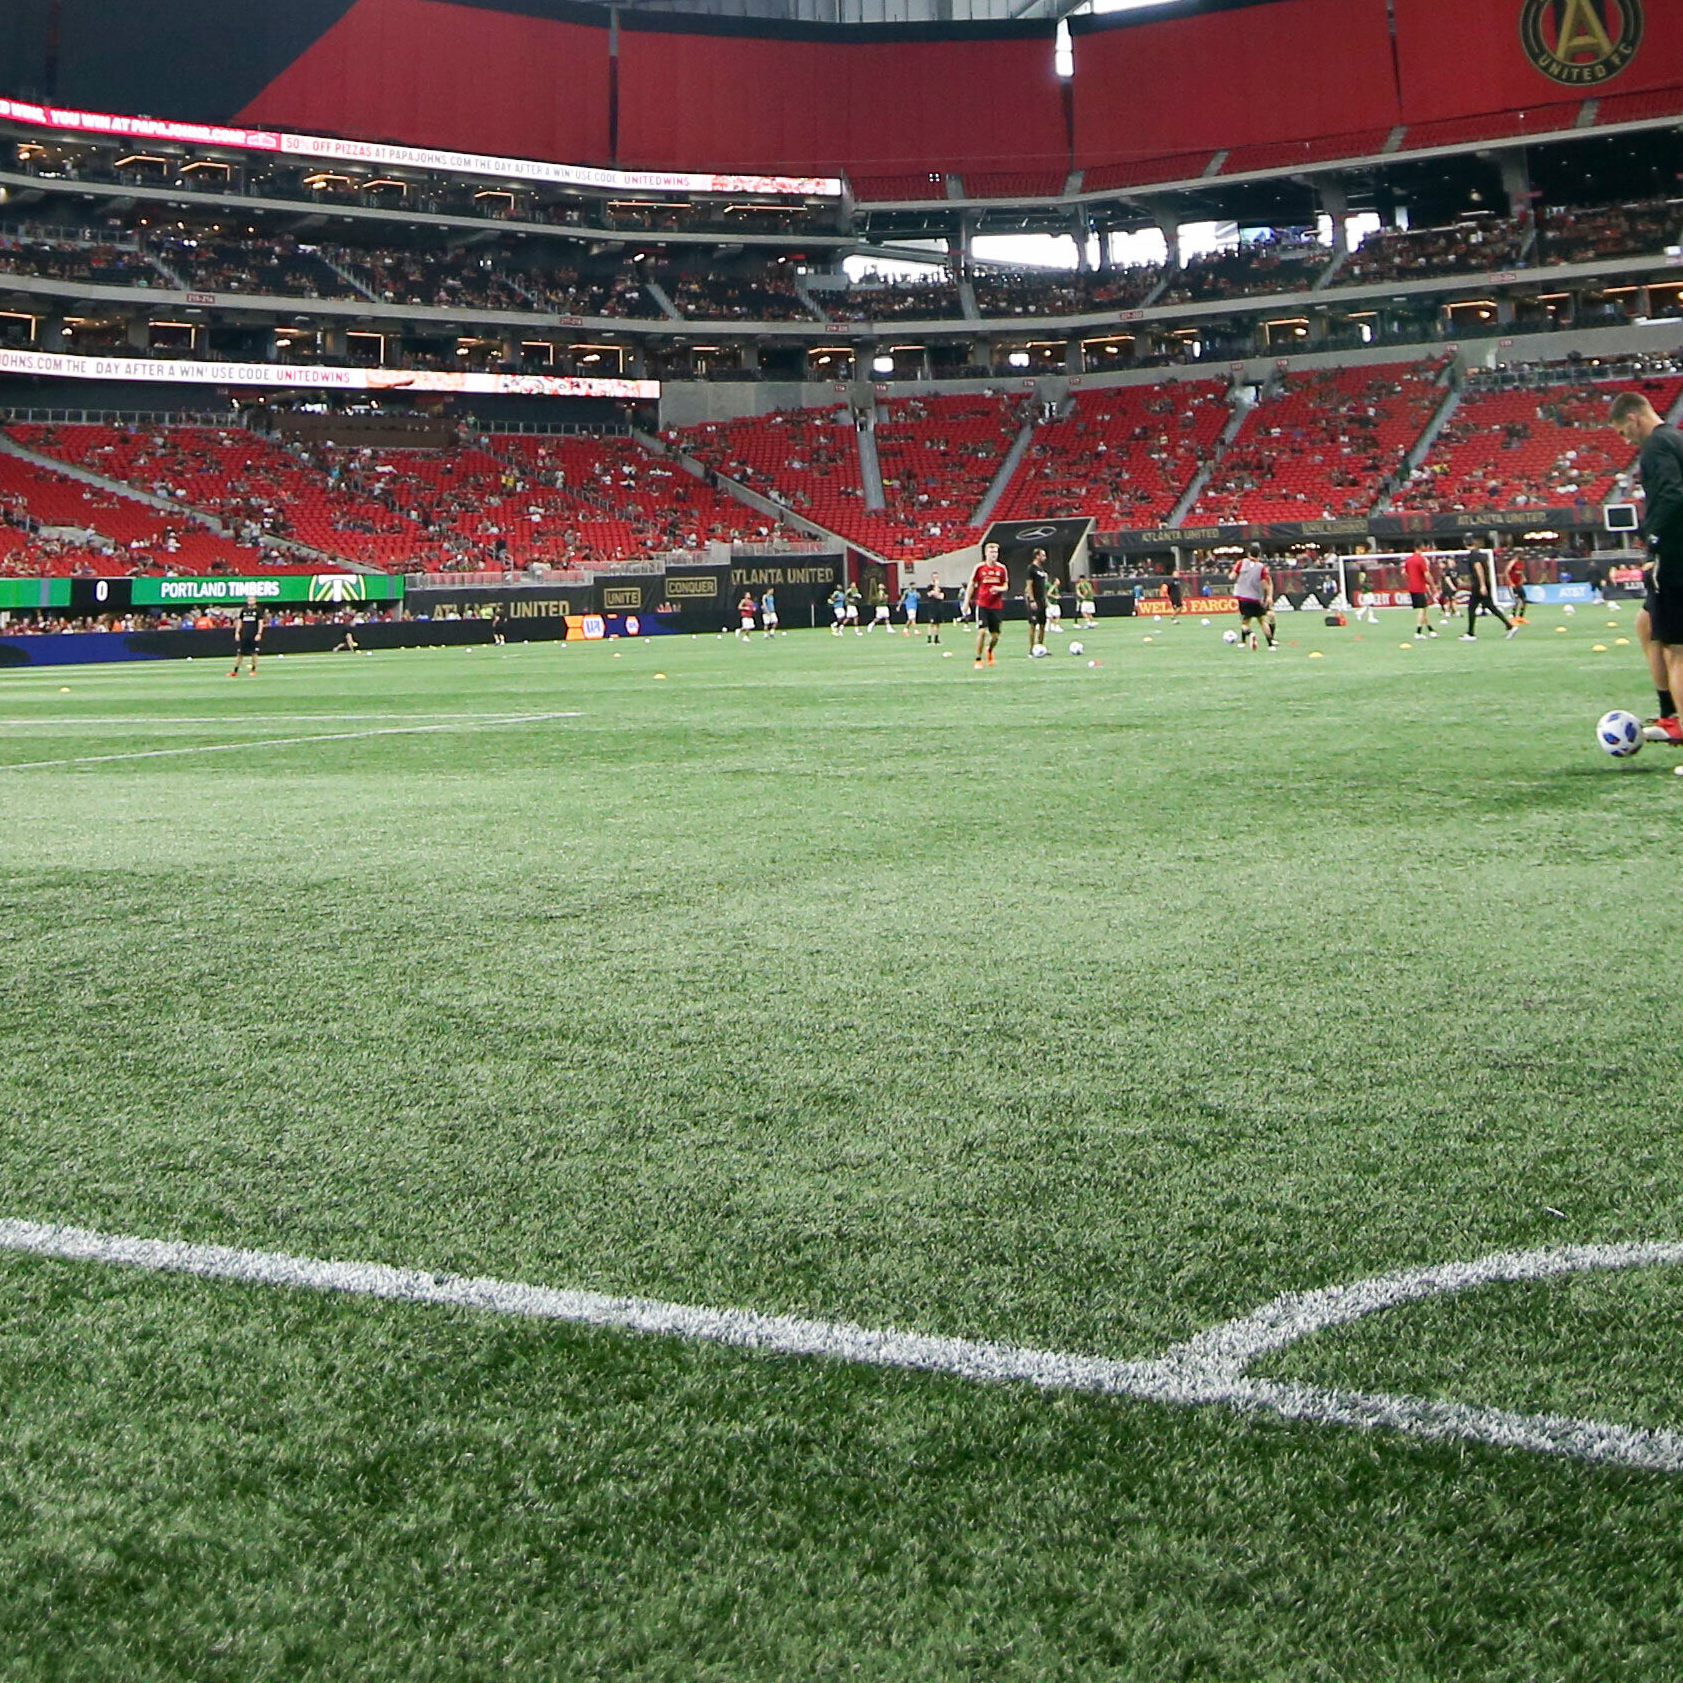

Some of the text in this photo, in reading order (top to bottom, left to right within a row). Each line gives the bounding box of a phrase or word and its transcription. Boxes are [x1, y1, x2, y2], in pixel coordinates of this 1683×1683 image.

[1539, 43, 1632, 80] UNITED FC
[50, 109, 80, 127] YOU
[81, 114, 111, 130] WIN
[111, 118, 131, 132] AT
[312, 141, 331, 152] OFF
[335, 144, 372, 157] PIZZAS
[375, 149, 386, 160] AT
[474, 158, 491, 169] THE
[494, 160, 511, 172] DAY
[515, 164, 542, 176] AFTER
[575, 169, 592, 180] USE
[624, 174, 690, 187] UNITEDWINS
[66, 359, 86, 373] THE
[96, 362, 119, 375] DAY
[125, 363, 164, 376] AFTER
[169, 365, 175, 376] A
[211, 367, 234, 379] USE
[276, 369, 350, 384] UNITEDWINS
[786, 567, 835, 583] UNITED
[95, 580, 109, 601] 0
[160, 582, 227, 599] PORTLAND
[228, 581, 280, 597] TIMBERS
[669, 581, 714, 595] CONQUER
[510, 599, 570, 618] UNITED
[607, 592, 639, 606] UNITE
